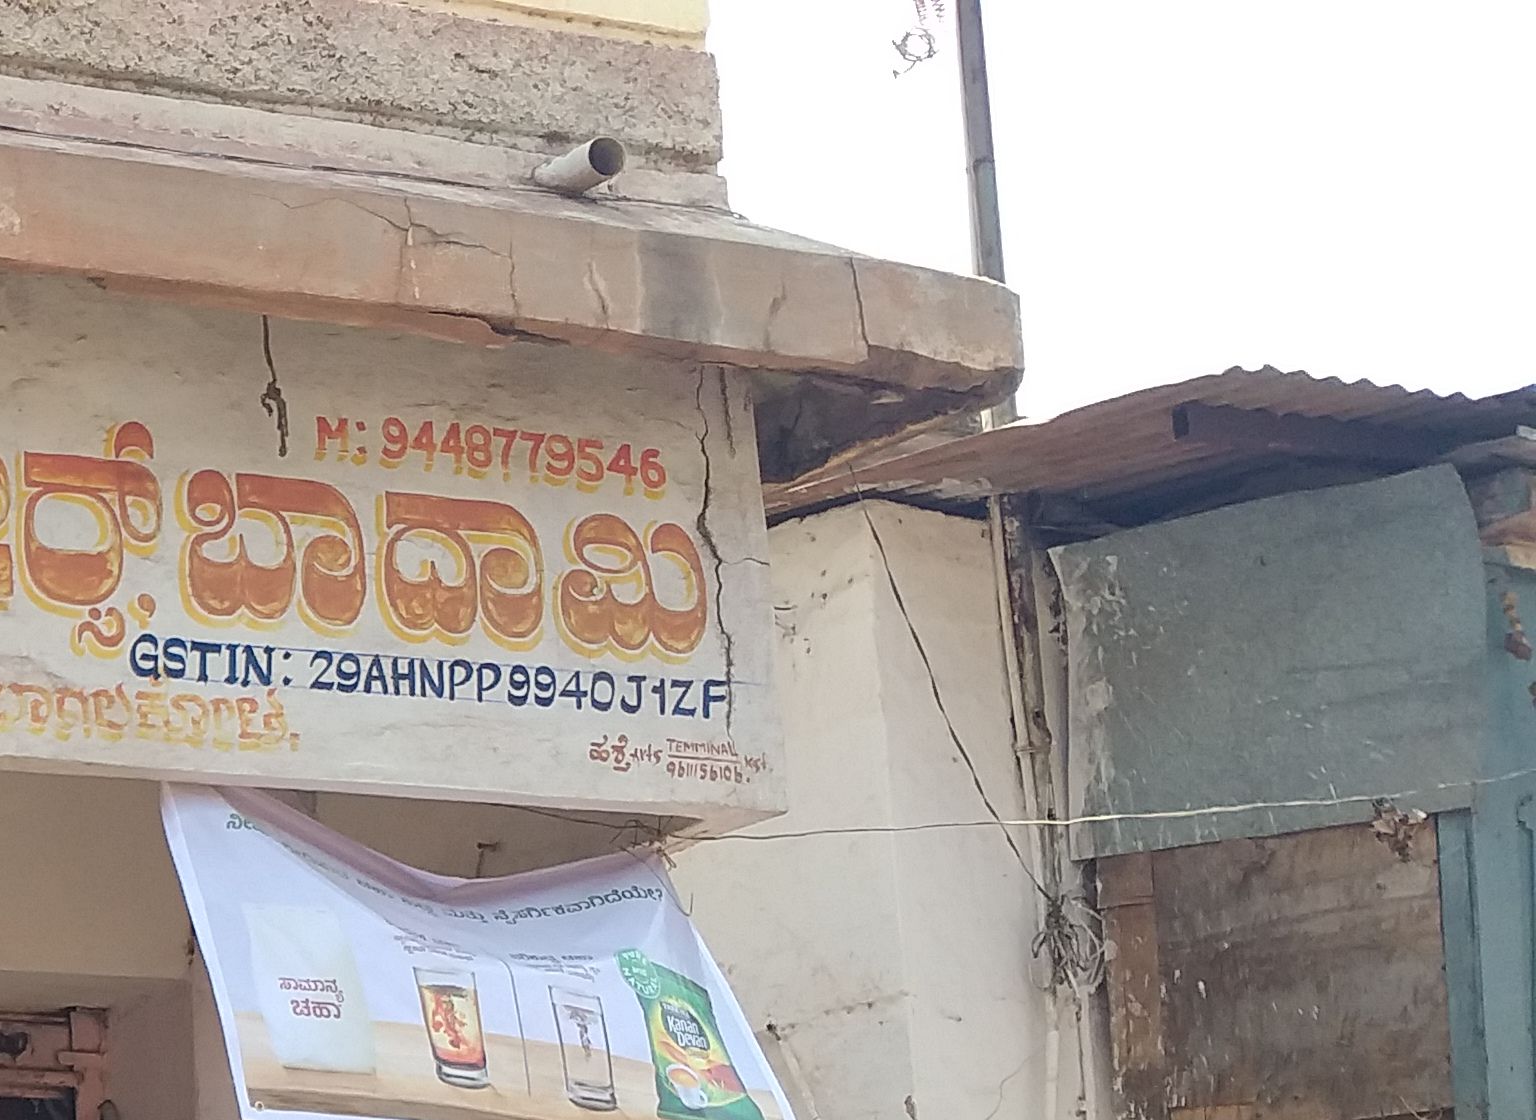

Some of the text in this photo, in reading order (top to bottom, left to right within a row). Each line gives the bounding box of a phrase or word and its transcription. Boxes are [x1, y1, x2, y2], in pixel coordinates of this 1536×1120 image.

[378, 416, 669, 500] 9448779546
[173, 466, 710, 667] ಬಾದಾಮಿ
[308, 650, 730, 720] 29AHNPP9940J1ZF
[278, 977, 344, 1003] ಸಾಮಾನ್ಯ
[666, 1015, 700, 1036] Kanan
[676, 1031, 708, 1050] Devan
